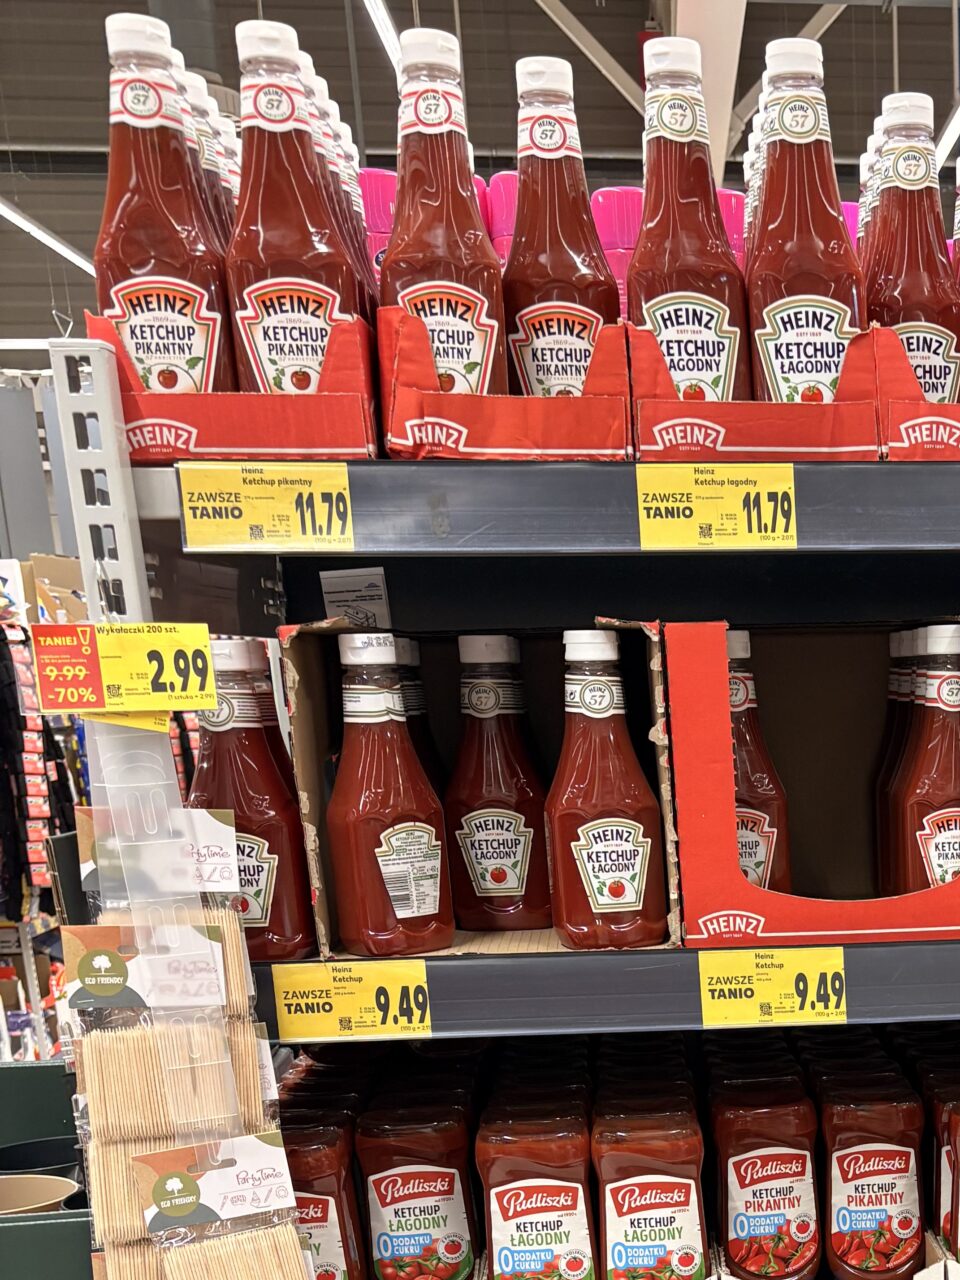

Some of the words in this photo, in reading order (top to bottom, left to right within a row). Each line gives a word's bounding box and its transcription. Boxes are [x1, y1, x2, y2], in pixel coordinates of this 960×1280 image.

[263, 87, 283, 97] HEINZ
[265, 99, 282, 110] 57
[127, 293, 191, 317] HEINZ
[129, 324, 196, 343] KETCHUP
[135, 341, 193, 356] PIKANTNY
[128, 427, 191, 450] HEINZ
[657, 427, 719, 448] HEINZ
[242, 476, 278, 487] Ketchup
[280, 477, 313, 487] pikantny
[727, 478, 757, 486] łagodny
[188, 492, 241, 503] ZAWSZE
[642, 493, 692, 502] ZAWSZE
[189, 507, 242, 520] TANIO
[295, 491, 348, 535] 11.79
[644, 507, 694, 518] TANIO
[742, 491, 792, 533] 11.79
[96, 626, 144, 635] Wykałaczki
[38, 636, 77, 646] TANIEJ
[45, 666, 87, 681] 9.99
[147, 649, 208, 692] 2.99
[48, 687, 97, 702] -70%
[591, 828, 631, 845] HEINZ
[586, 849, 640, 863] KETCHUP
[591, 862, 636, 873] ŁAGODNY
[705, 916, 758, 935] HEINZ
[85, 977, 96, 985] ECO
[332, 975, 363, 984] Ketchup
[283, 990, 332, 1000] ZAWSZE
[794, 971, 845, 1010] 9.49
[284, 1002, 333, 1014] TANIO
[376, 984, 428, 1025] 9.49
[752, 1186, 794, 1199] KETCHUP
[503, 1189, 573, 1215] Pudliszki
[744, 1196, 801, 1213] PIKANTNY
[516, 1219, 563, 1233] KETCHUP
[510, 1231, 571, 1247] ŁAGODNY
[514, 1250, 552, 1262] DODATKU
[514, 1259, 541, 1270] CUKRU
